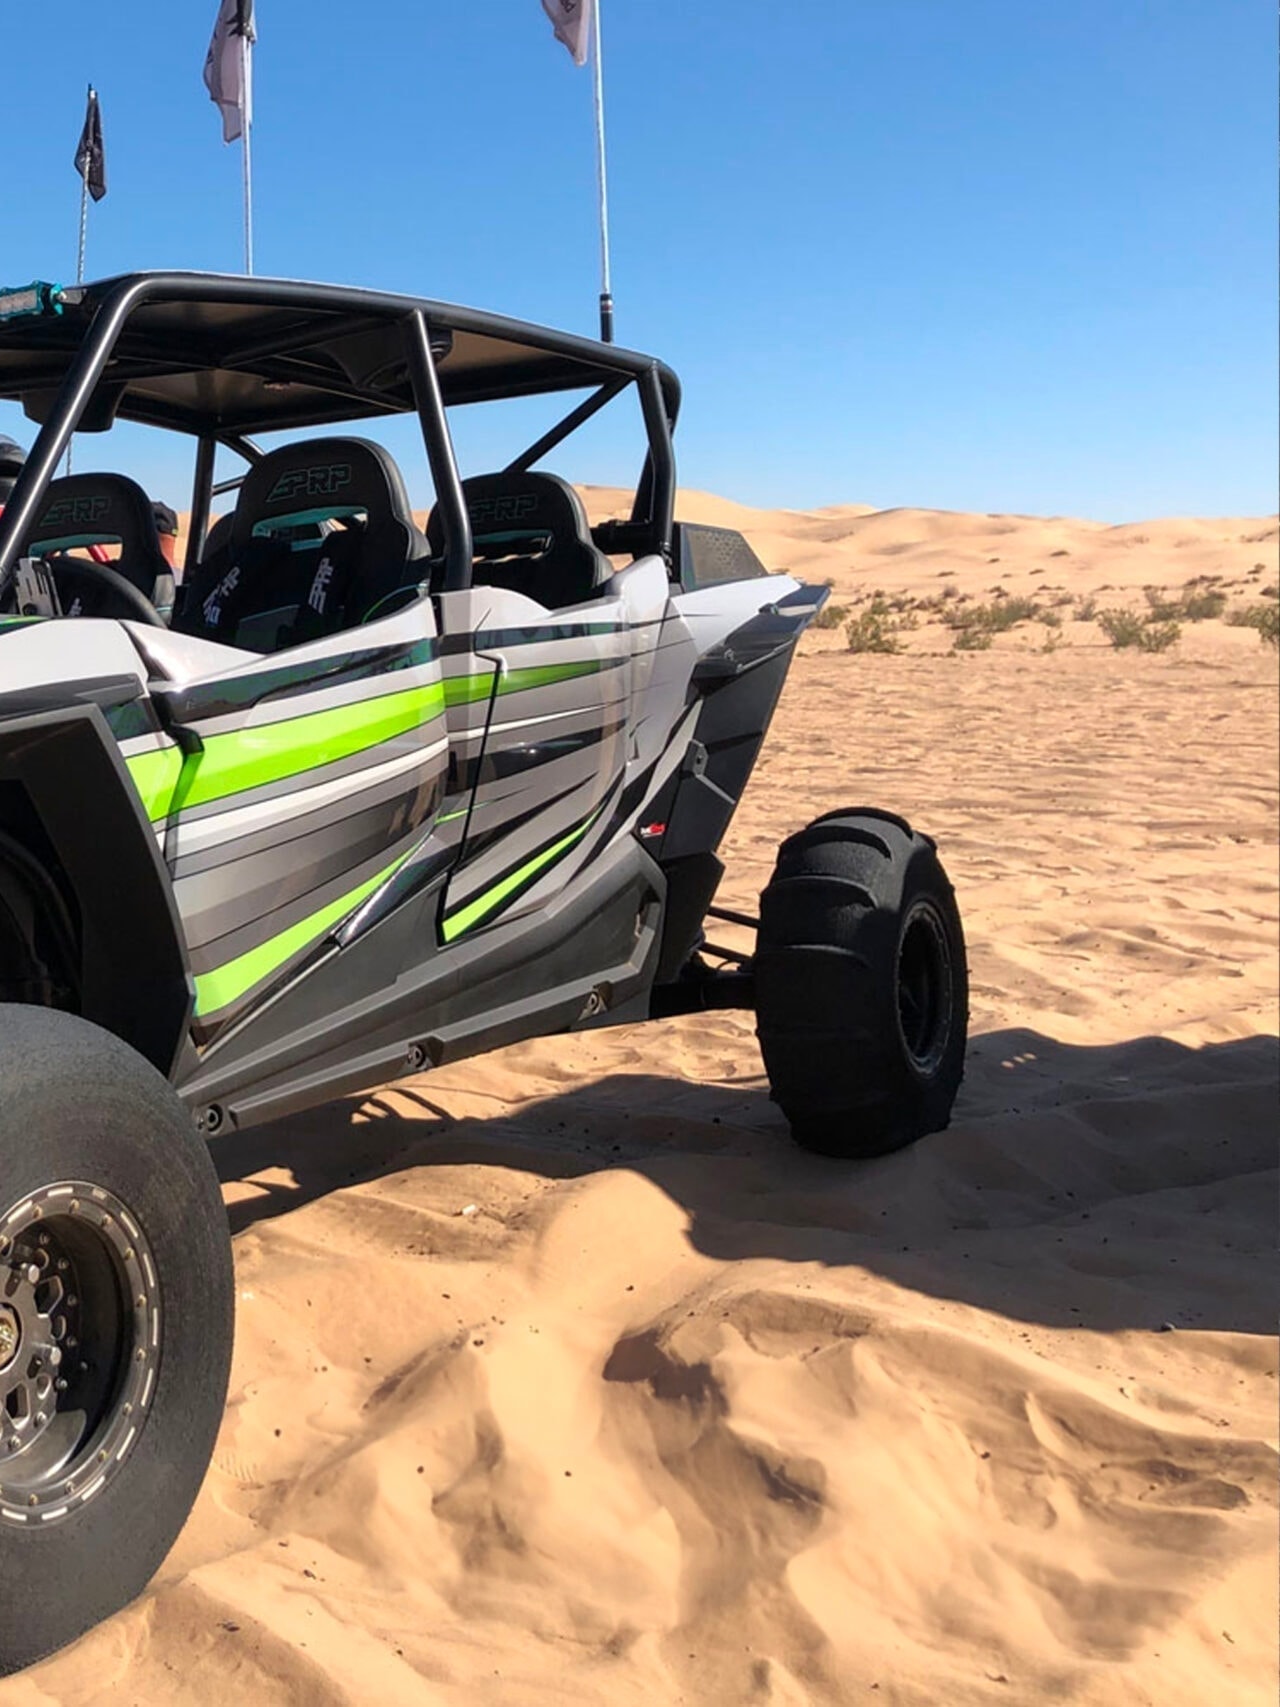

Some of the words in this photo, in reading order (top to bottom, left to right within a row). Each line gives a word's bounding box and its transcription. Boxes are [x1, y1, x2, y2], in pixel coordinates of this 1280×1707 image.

[266, 464, 352, 502] PRP
[40, 496, 111, 527] PRP
[308, 557, 333, 614] PRP
